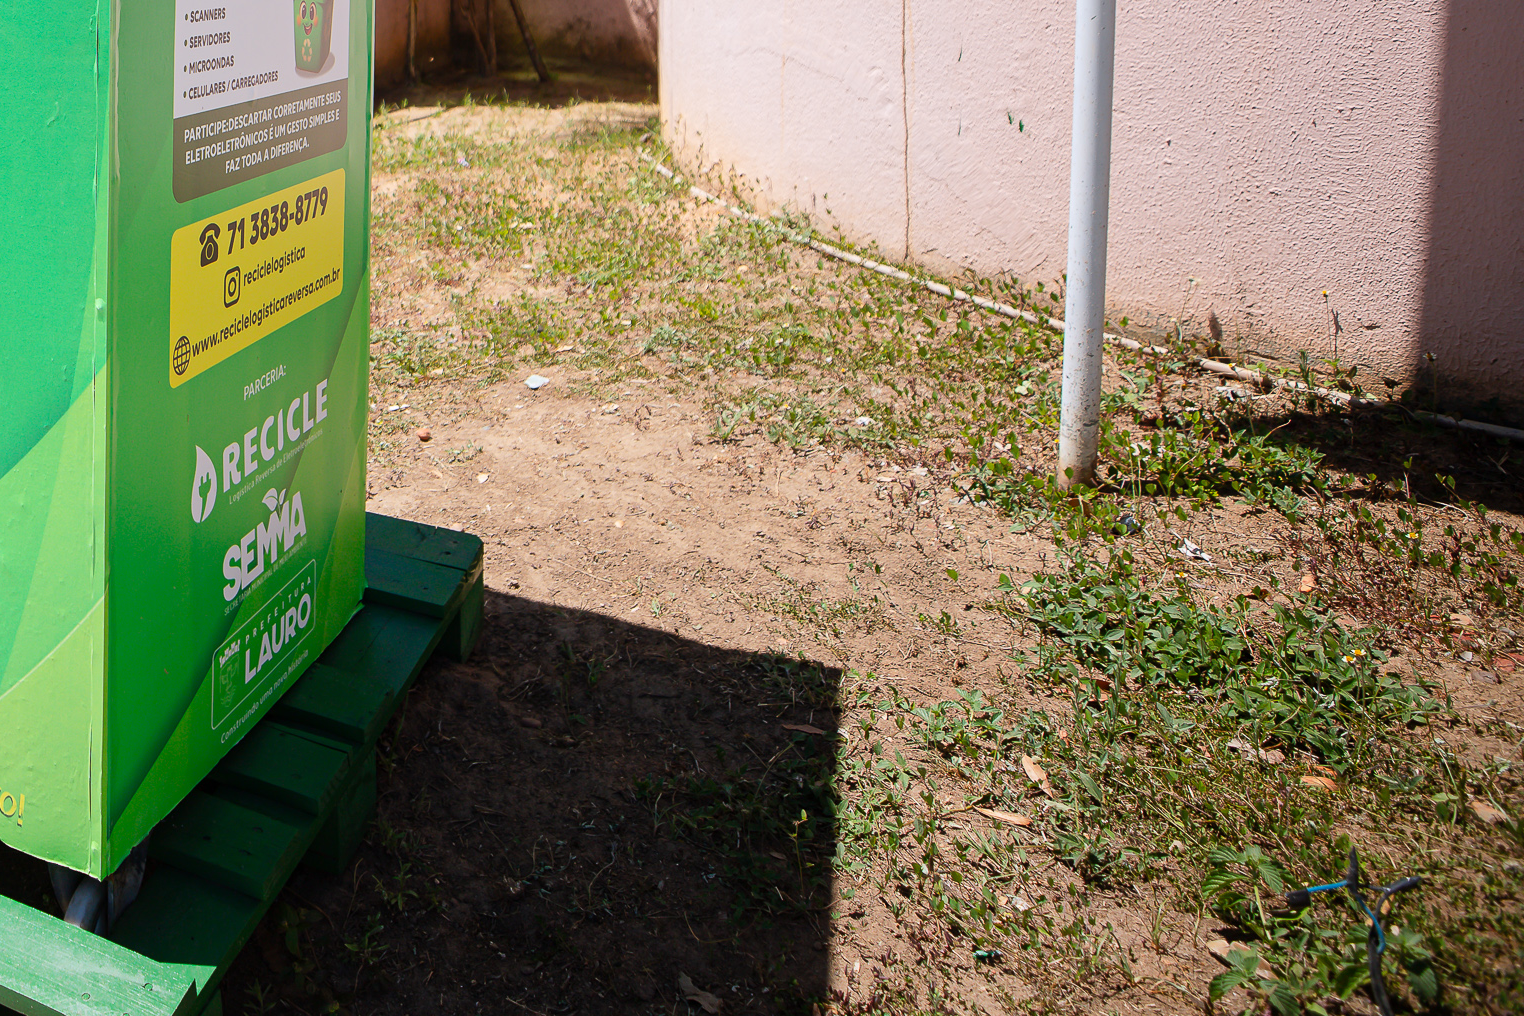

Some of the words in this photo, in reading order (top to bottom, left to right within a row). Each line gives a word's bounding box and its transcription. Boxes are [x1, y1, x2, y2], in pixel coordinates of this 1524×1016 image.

[190, 7, 226, 23] SCANNERS
[189, 31, 231, 48] SERVIDORES
[188, 55, 235, 74] MICROONDAS
[188, 80, 226, 100] CELULARES
[231, 70, 279, 91] CARREGADORES
[273, 95, 325, 119] CORRETAMENTE
[325, 90, 341, 106] SEUS
[185, 129, 268, 165] ELETROELETRÔNICOS
[269, 123, 274, 140] É
[274, 122, 286, 139] UM
[286, 118, 308, 137] GESTO
[308, 112, 335, 131] SIMPLES
[335, 110, 340, 122] E
[225, 157, 240, 174] FAZ
[241, 151, 262, 170] TODA
[263, 150, 269, 165] A
[270, 138, 310, 162] DIFERENÇA.
[227, 217, 245, 255] 71
[249, 186, 328, 244] 3838-8779
[243, 245, 306, 287] reciclelogistica
[191, 267, 341, 358] www.reciclelogisticareversa.com.br
[243, 364, 287, 401] PARCERIA:
[222, 378, 328, 493] RECICLE
[255, 464, 276, 485] Reversa
[276, 459, 283, 469] de
[222, 491, 307, 603] SEMMA
[245, 576, 311, 645] PREFEITURA
[244, 593, 312, 684] LAURO
[220, 700, 260, 744] Construindo
[259, 687, 273, 705] uma
[273, 672, 288, 691] nova
